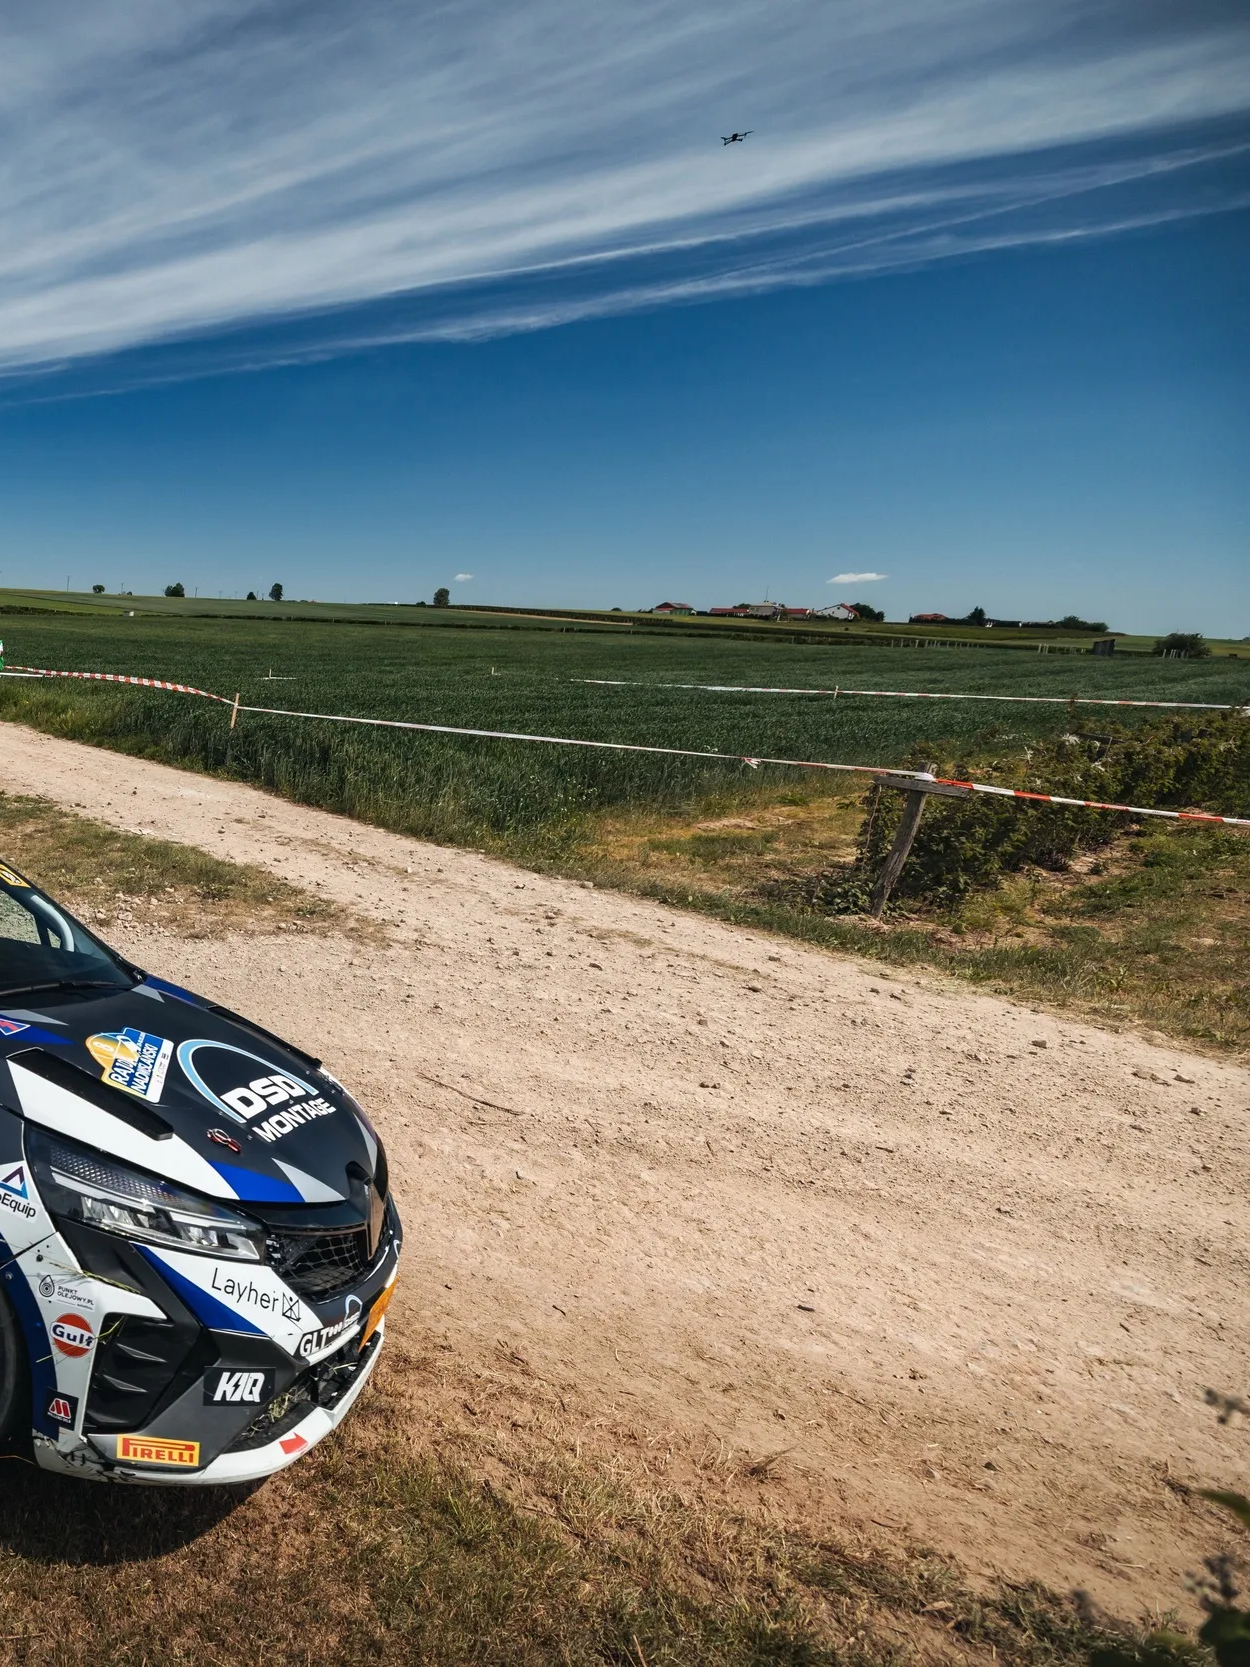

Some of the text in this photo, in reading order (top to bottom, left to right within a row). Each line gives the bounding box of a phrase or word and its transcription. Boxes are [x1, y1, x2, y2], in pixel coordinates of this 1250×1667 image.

[220, 1075, 306, 1119] DSD
[252, 1097, 337, 1142] MONTAGE
[58, 1286, 78, 1294] PUNKT
[211, 1267, 279, 1312] Layher
[52, 1324, 93, 1347] Gulf
[122, 1437, 195, 1463] PIRELLI
